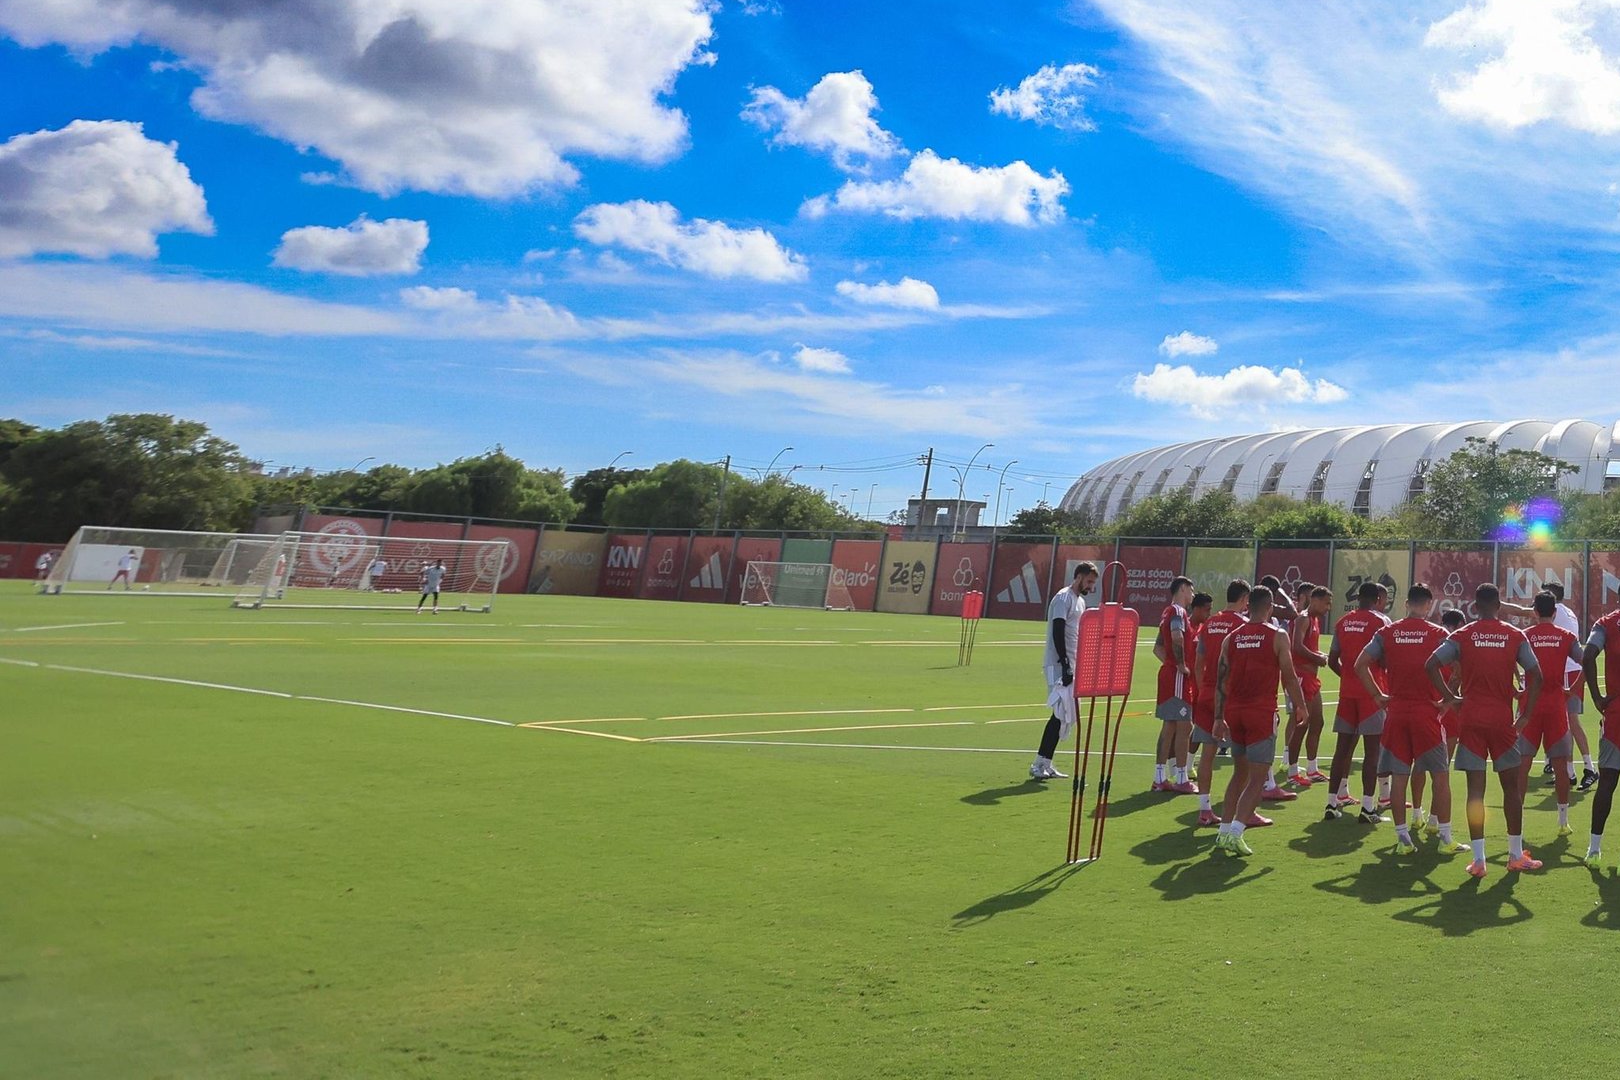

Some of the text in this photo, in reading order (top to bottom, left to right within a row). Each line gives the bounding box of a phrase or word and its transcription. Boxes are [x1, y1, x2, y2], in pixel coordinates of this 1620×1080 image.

[607, 546, 643, 569] KNN
[832, 568, 869, 587] Claro
[890, 562, 910, 586] Zé
[1126, 569, 1146, 578] SEJA
[1126, 580, 1146, 588] SEJA
[1507, 567, 1573, 600] KNN
[940, 590, 964, 601] banr
[1474, 640, 1506, 648] Unimed
